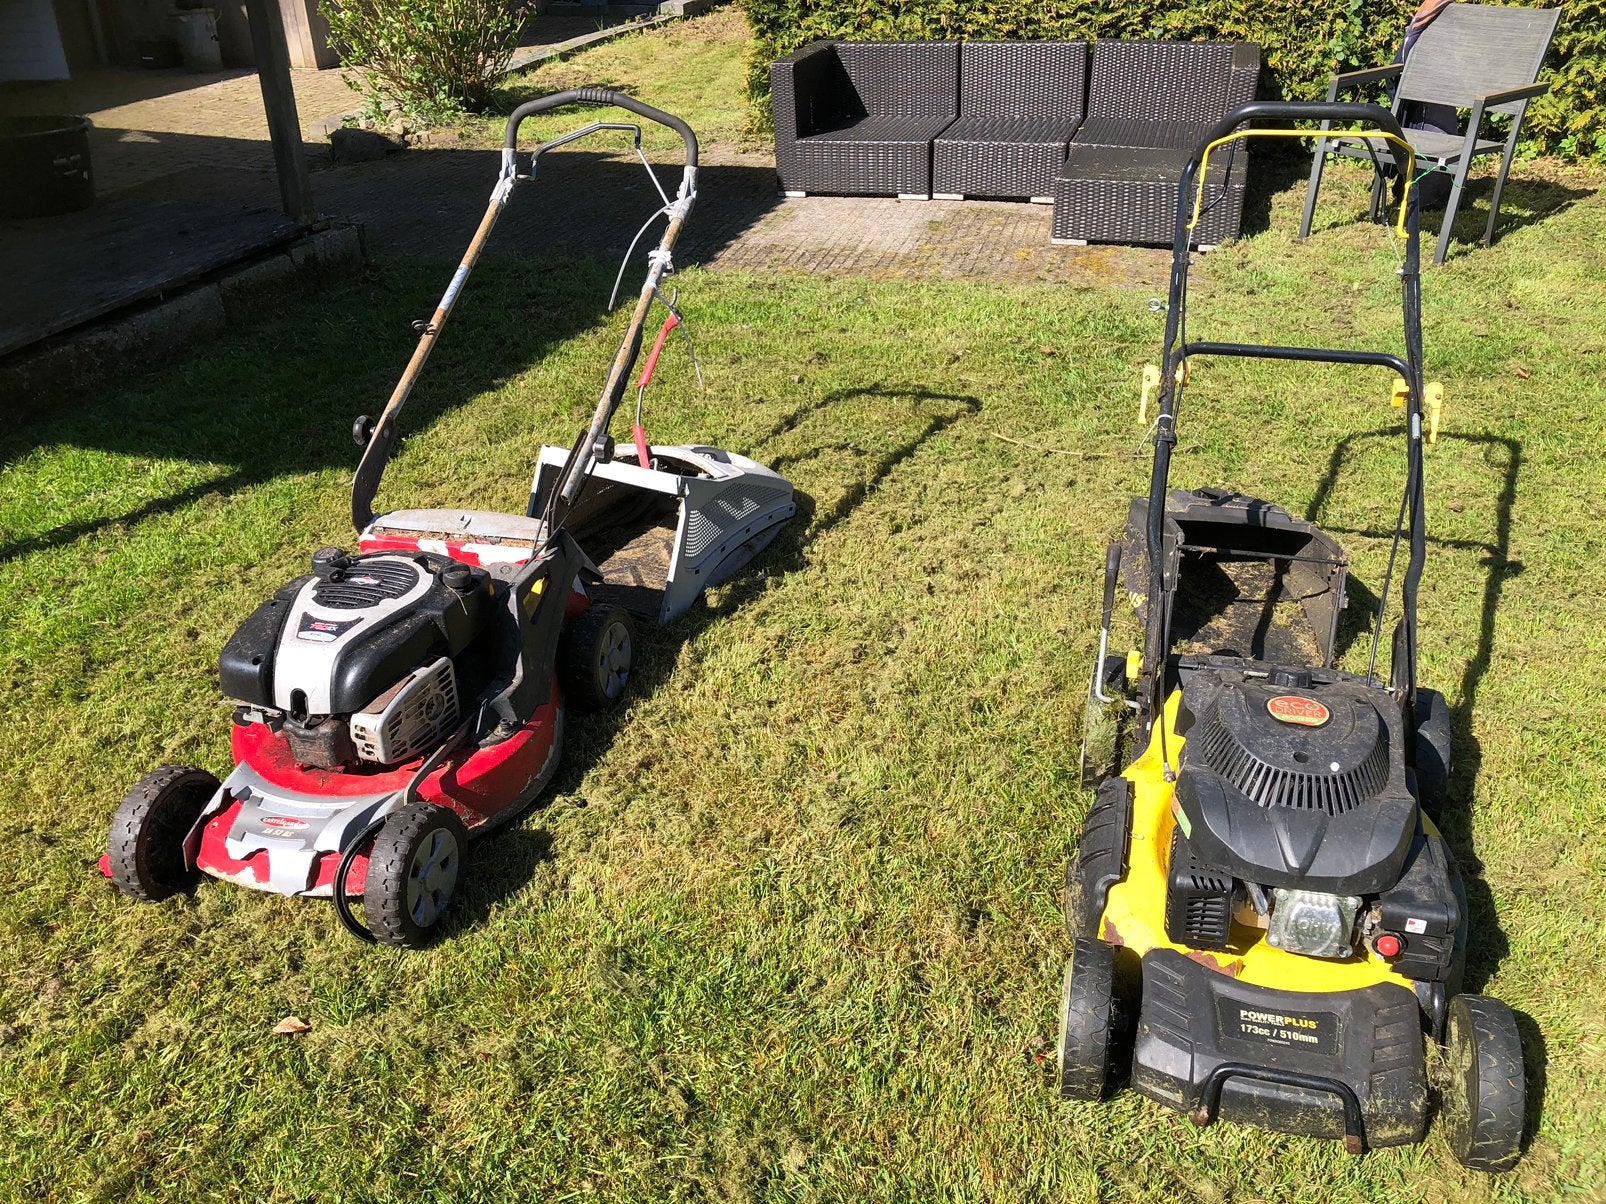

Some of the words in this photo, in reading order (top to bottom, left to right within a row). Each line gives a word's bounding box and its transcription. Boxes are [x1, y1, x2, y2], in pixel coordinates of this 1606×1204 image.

[1275, 706, 1322, 718] DRIVER
[1240, 1010, 1317, 1029] POWERPLUS
[1240, 1024, 1270, 1036] 173cc
[1279, 1030, 1319, 1044] 510mm
